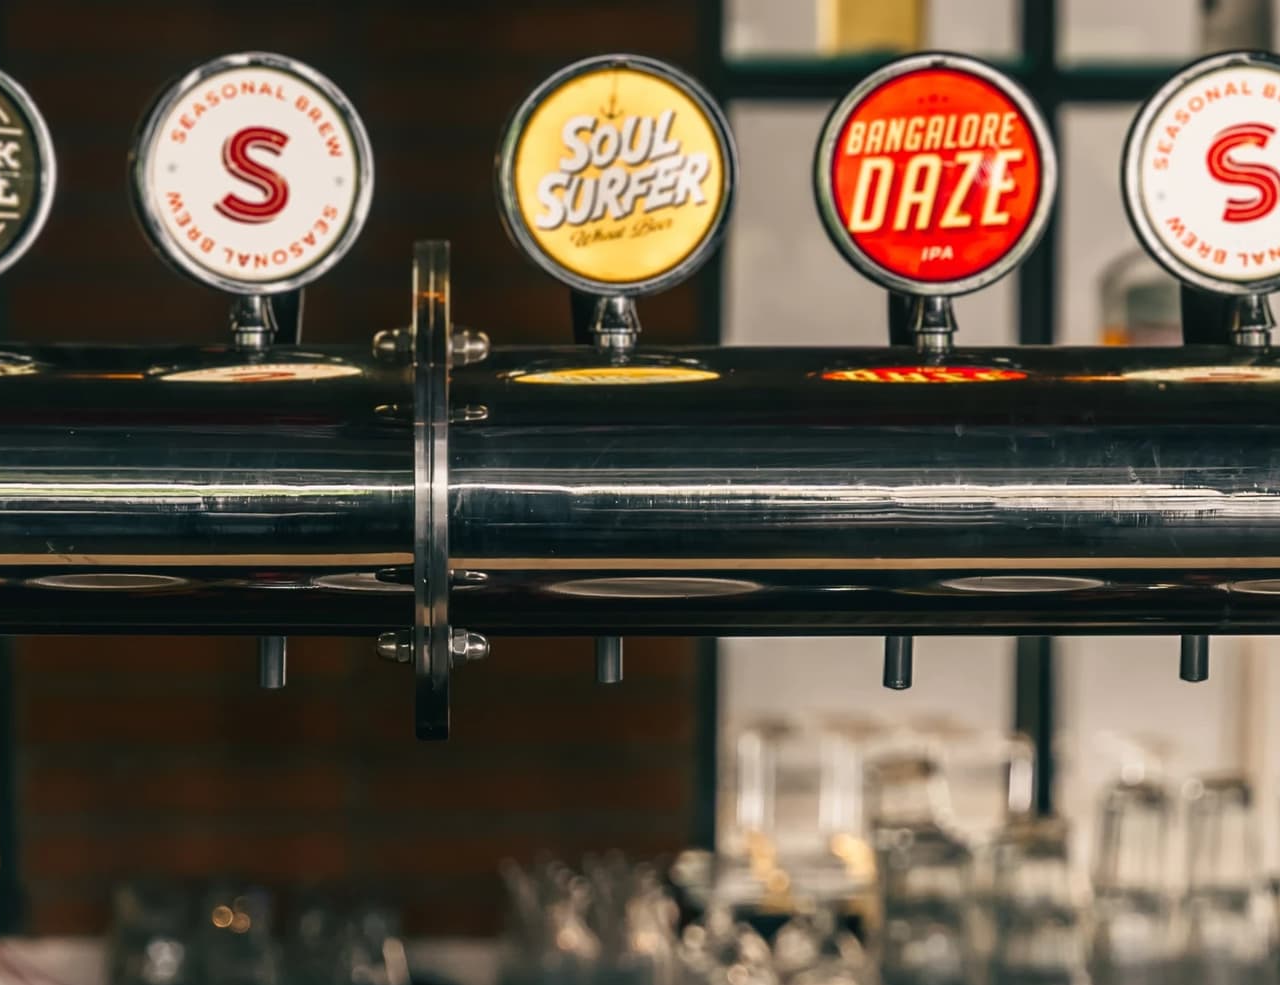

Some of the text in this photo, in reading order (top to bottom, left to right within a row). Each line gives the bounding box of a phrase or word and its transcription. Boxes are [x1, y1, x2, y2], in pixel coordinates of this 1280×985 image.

[171, 80, 343, 157] SEASONAL BREW
[559, 108, 681, 173] SOUL
[846, 112, 1018, 156] BANGALORE
[1153, 80, 1253, 171] SEASONAL
[213, 125, 290, 225] S
[535, 152, 711, 231] SURFER
[848, 149, 1025, 233] DAZE
[166, 191, 338, 269] SEASONAL BREW
[921, 245, 954, 262] IPA
[1165, 216, 1227, 265] BREW
